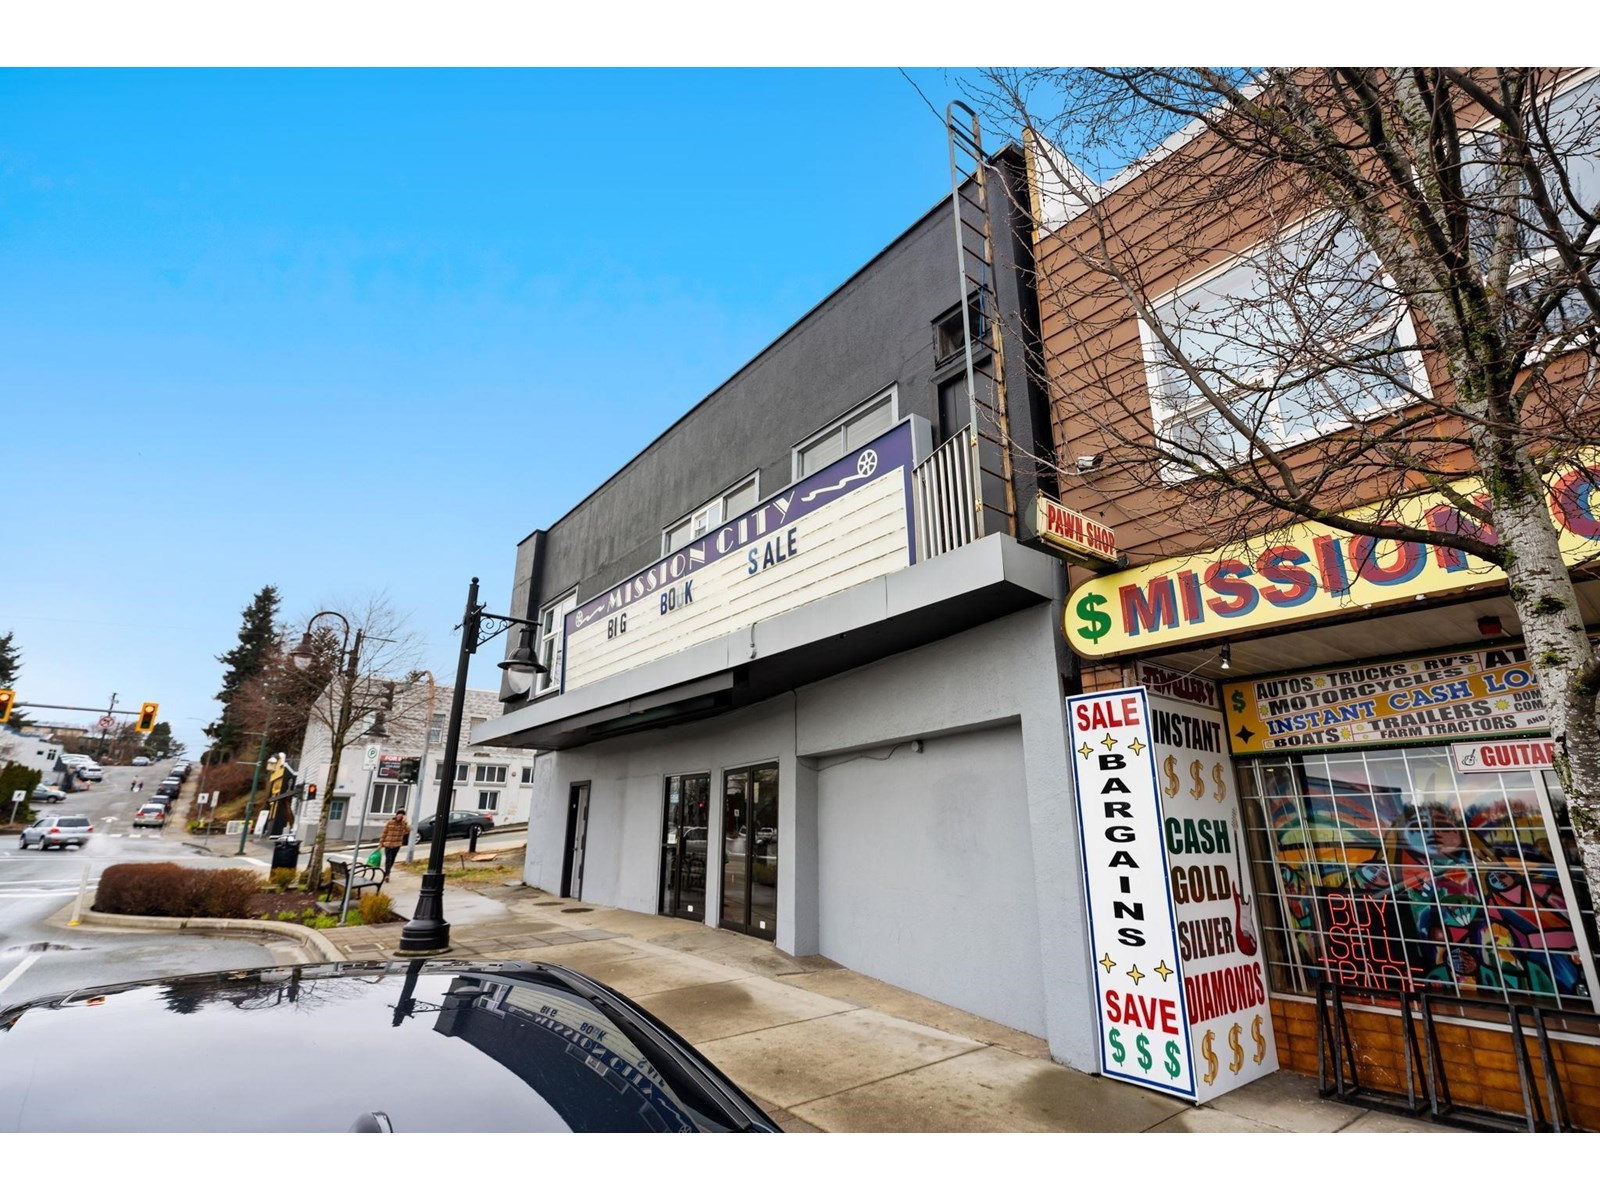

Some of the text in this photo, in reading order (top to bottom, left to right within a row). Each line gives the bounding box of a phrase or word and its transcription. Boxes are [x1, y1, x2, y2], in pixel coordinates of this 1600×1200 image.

[607, 490, 795, 613] MISSION CITY
[1048, 504, 1115, 555] PAWN SHOP
[608, 527, 797, 640] BIG BOOK SALE
[1256, 654, 1474, 700] AUTOS TRUCKS RV'S
[1269, 667, 1464, 716] MOTORCYCLES
[1076, 698, 1140, 732] SALE
[1266, 670, 1537, 736] INSTANT CASH LO
[1368, 700, 1492, 730] TRAILERS
[1152, 709, 1221, 754] INSTANT
[1274, 728, 1340, 748] BOATS
[1380, 714, 1546, 738] FARM TRACTORS AND
[1098, 754, 1146, 947] BARGAINS
[1166, 817, 1231, 854] CASH
[1171, 866, 1231, 905] GOLD
[1328, 894, 1387, 928] BUY
[1178, 916, 1235, 962] SILVER
[1330, 926, 1405, 964] SELL
[1106, 990, 1179, 1035] SAVE
[1184, 961, 1264, 1026] DIAMONDS
